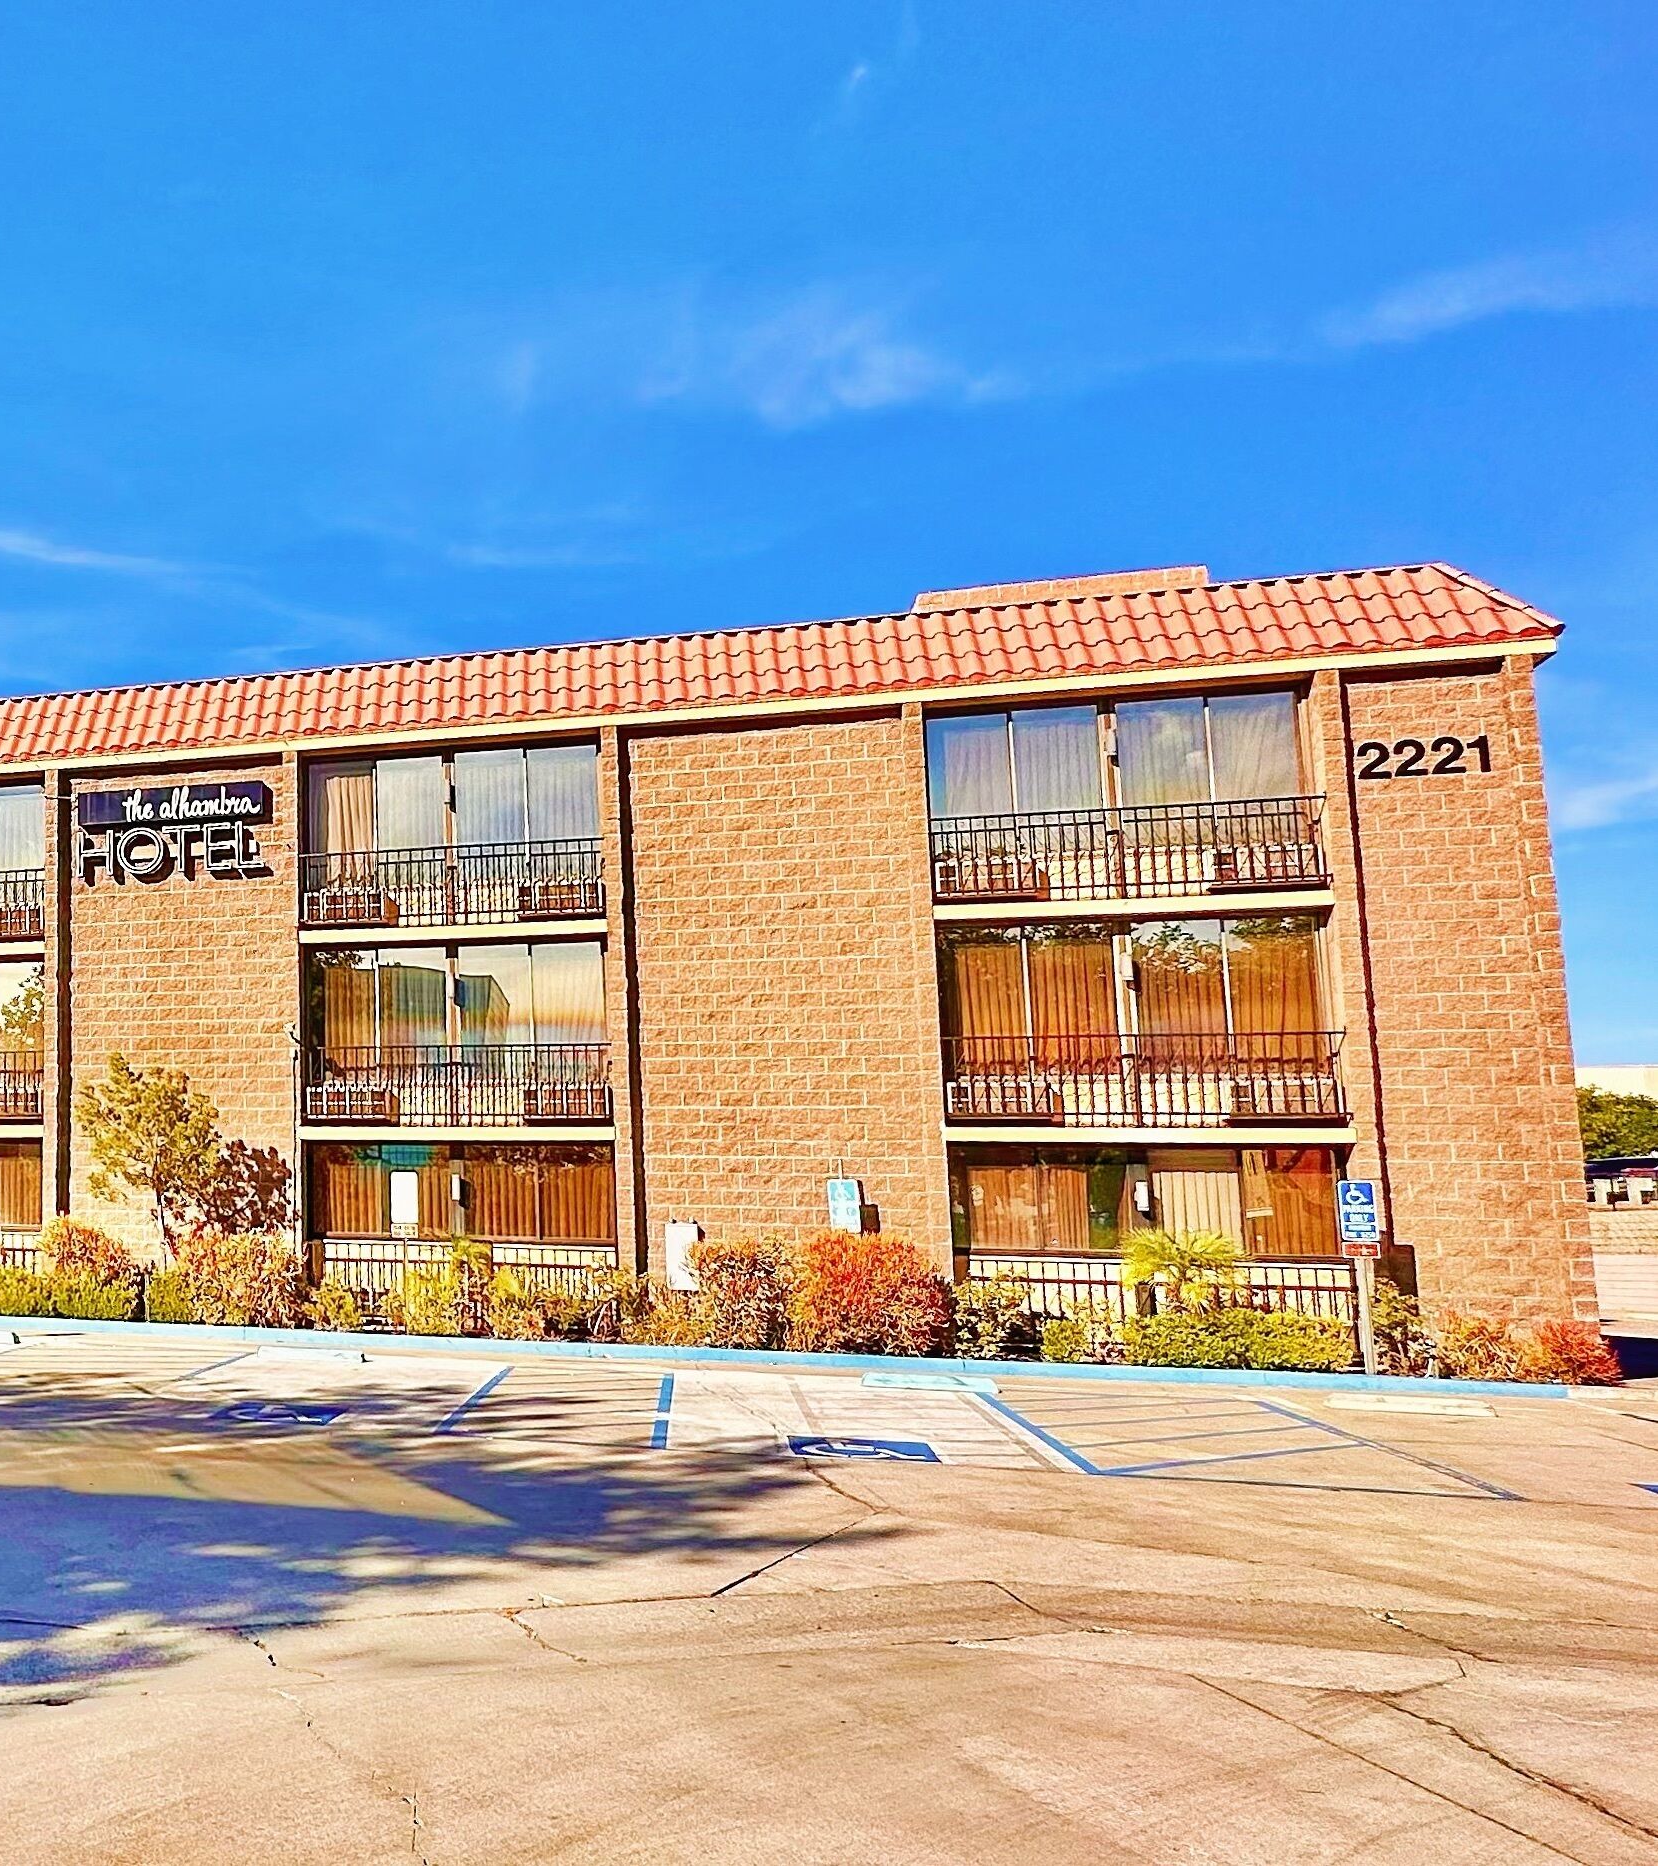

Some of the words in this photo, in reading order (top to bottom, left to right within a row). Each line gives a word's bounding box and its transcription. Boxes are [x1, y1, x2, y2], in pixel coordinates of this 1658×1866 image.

[1356, 735, 1492, 780] 2221
[122, 788, 155, 823] the
[159, 785, 261, 820] alhambra
[76, 820, 265, 878] HOTEL
